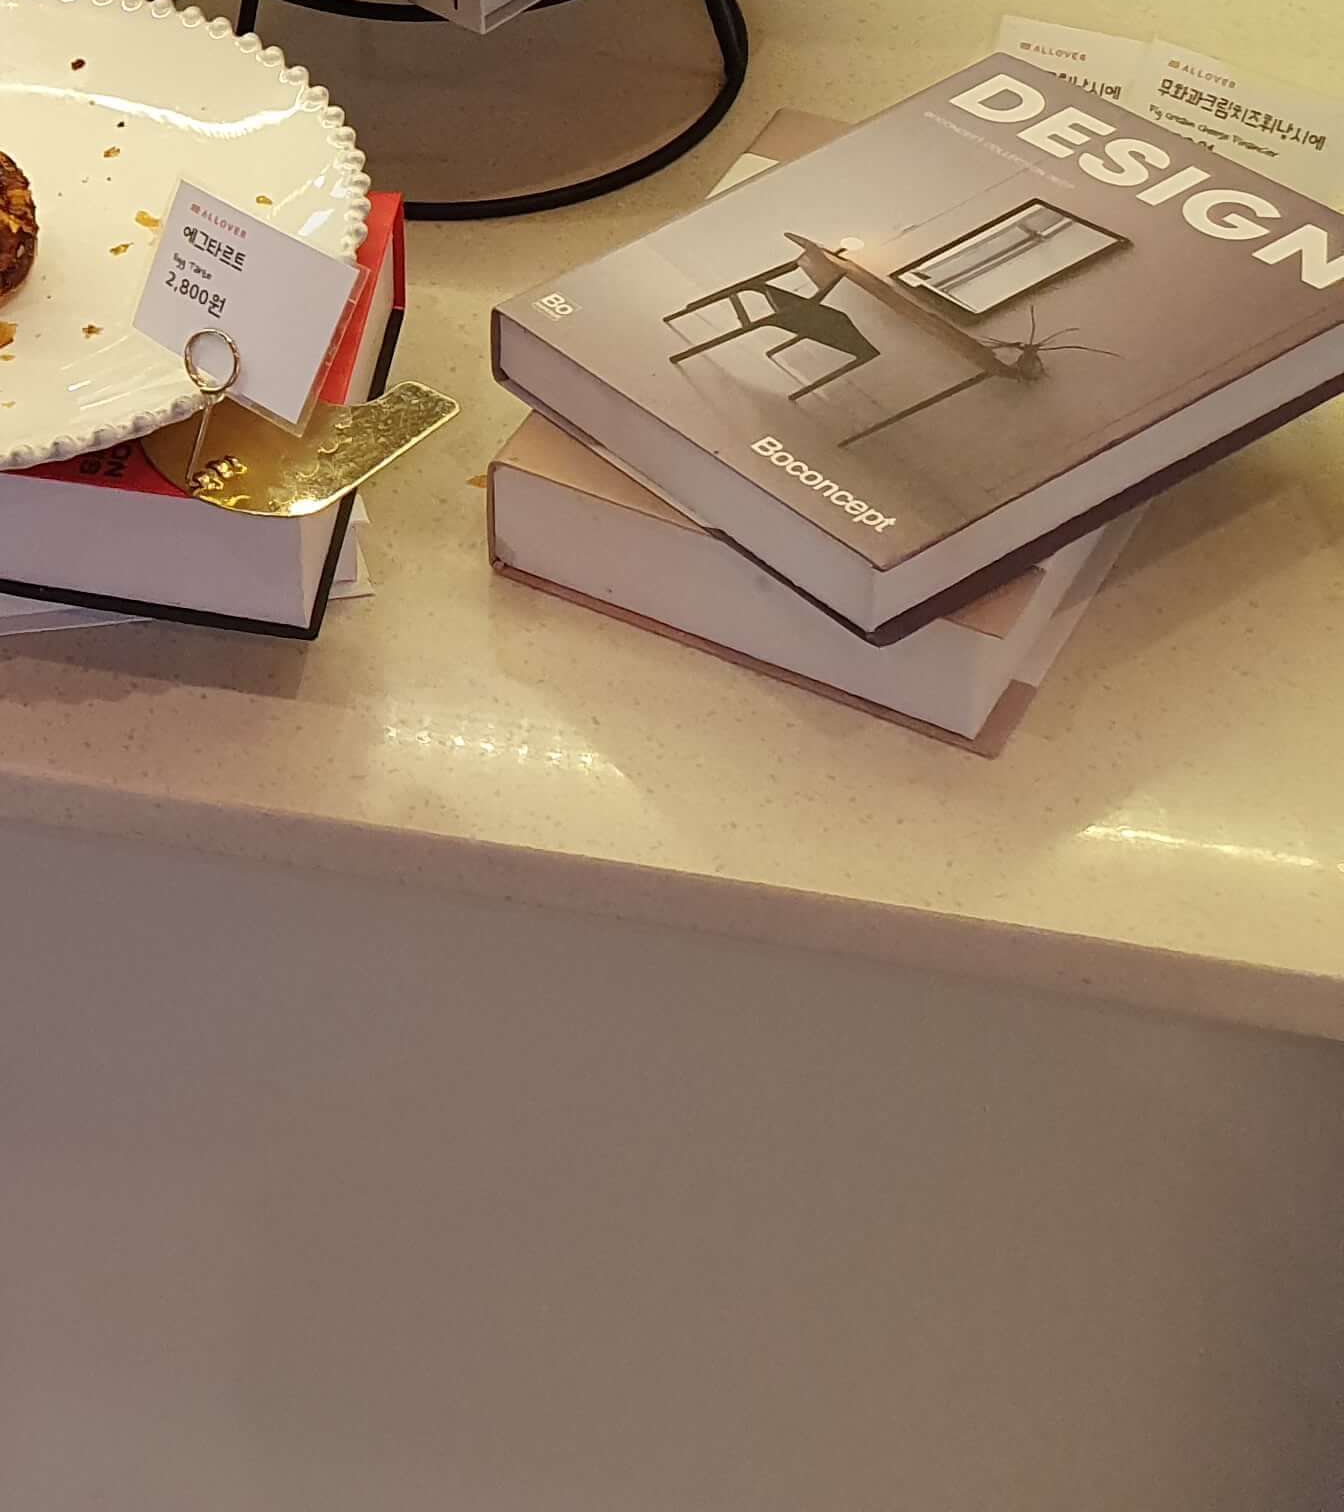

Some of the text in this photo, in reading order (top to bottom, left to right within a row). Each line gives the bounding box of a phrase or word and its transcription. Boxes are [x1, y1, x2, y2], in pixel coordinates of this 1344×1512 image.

[1033, 45, 1087, 62] ALLOVER
[1181, 64, 1237, 89] ALLOVER
[1157, 78, 1327, 151] 무화과크림치즈휘낭시에
[948, 73, 1344, 290] DESIGN
[201, 209, 247, 240] ALLOVER
[183, 226, 246, 272] 에그타르트
[165, 270, 227, 319] 2,800원
[541, 292, 573, 315] Bo
[751, 436, 897, 533] Boconcept
